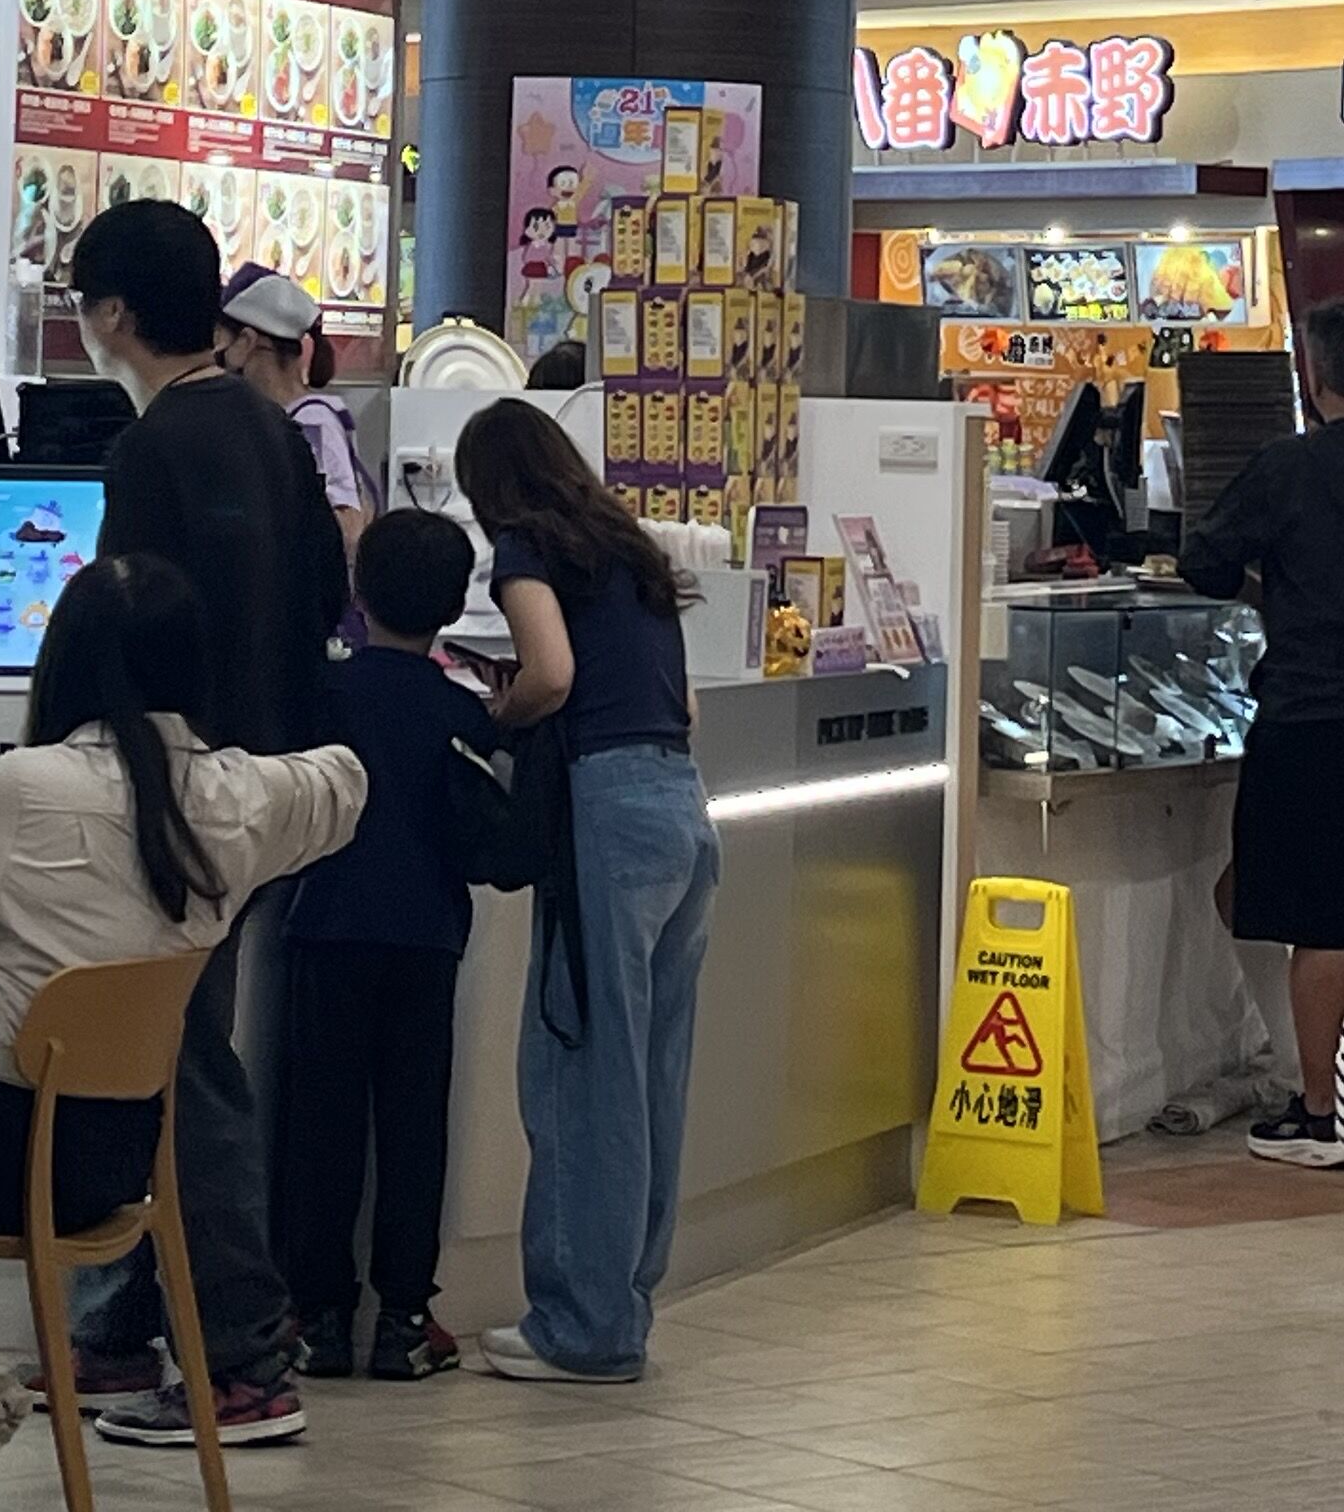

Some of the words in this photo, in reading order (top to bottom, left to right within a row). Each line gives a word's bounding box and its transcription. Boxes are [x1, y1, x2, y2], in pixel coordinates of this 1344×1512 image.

[619, 87, 655, 114] 21
[1021, 40, 1163, 143] 赤野
[978, 951, 1043, 969] CAUTION
[968, 969, 998, 987] WET
[1003, 970, 1049, 989] FLOOR
[950, 1080, 1042, 1130] 小心地滑
